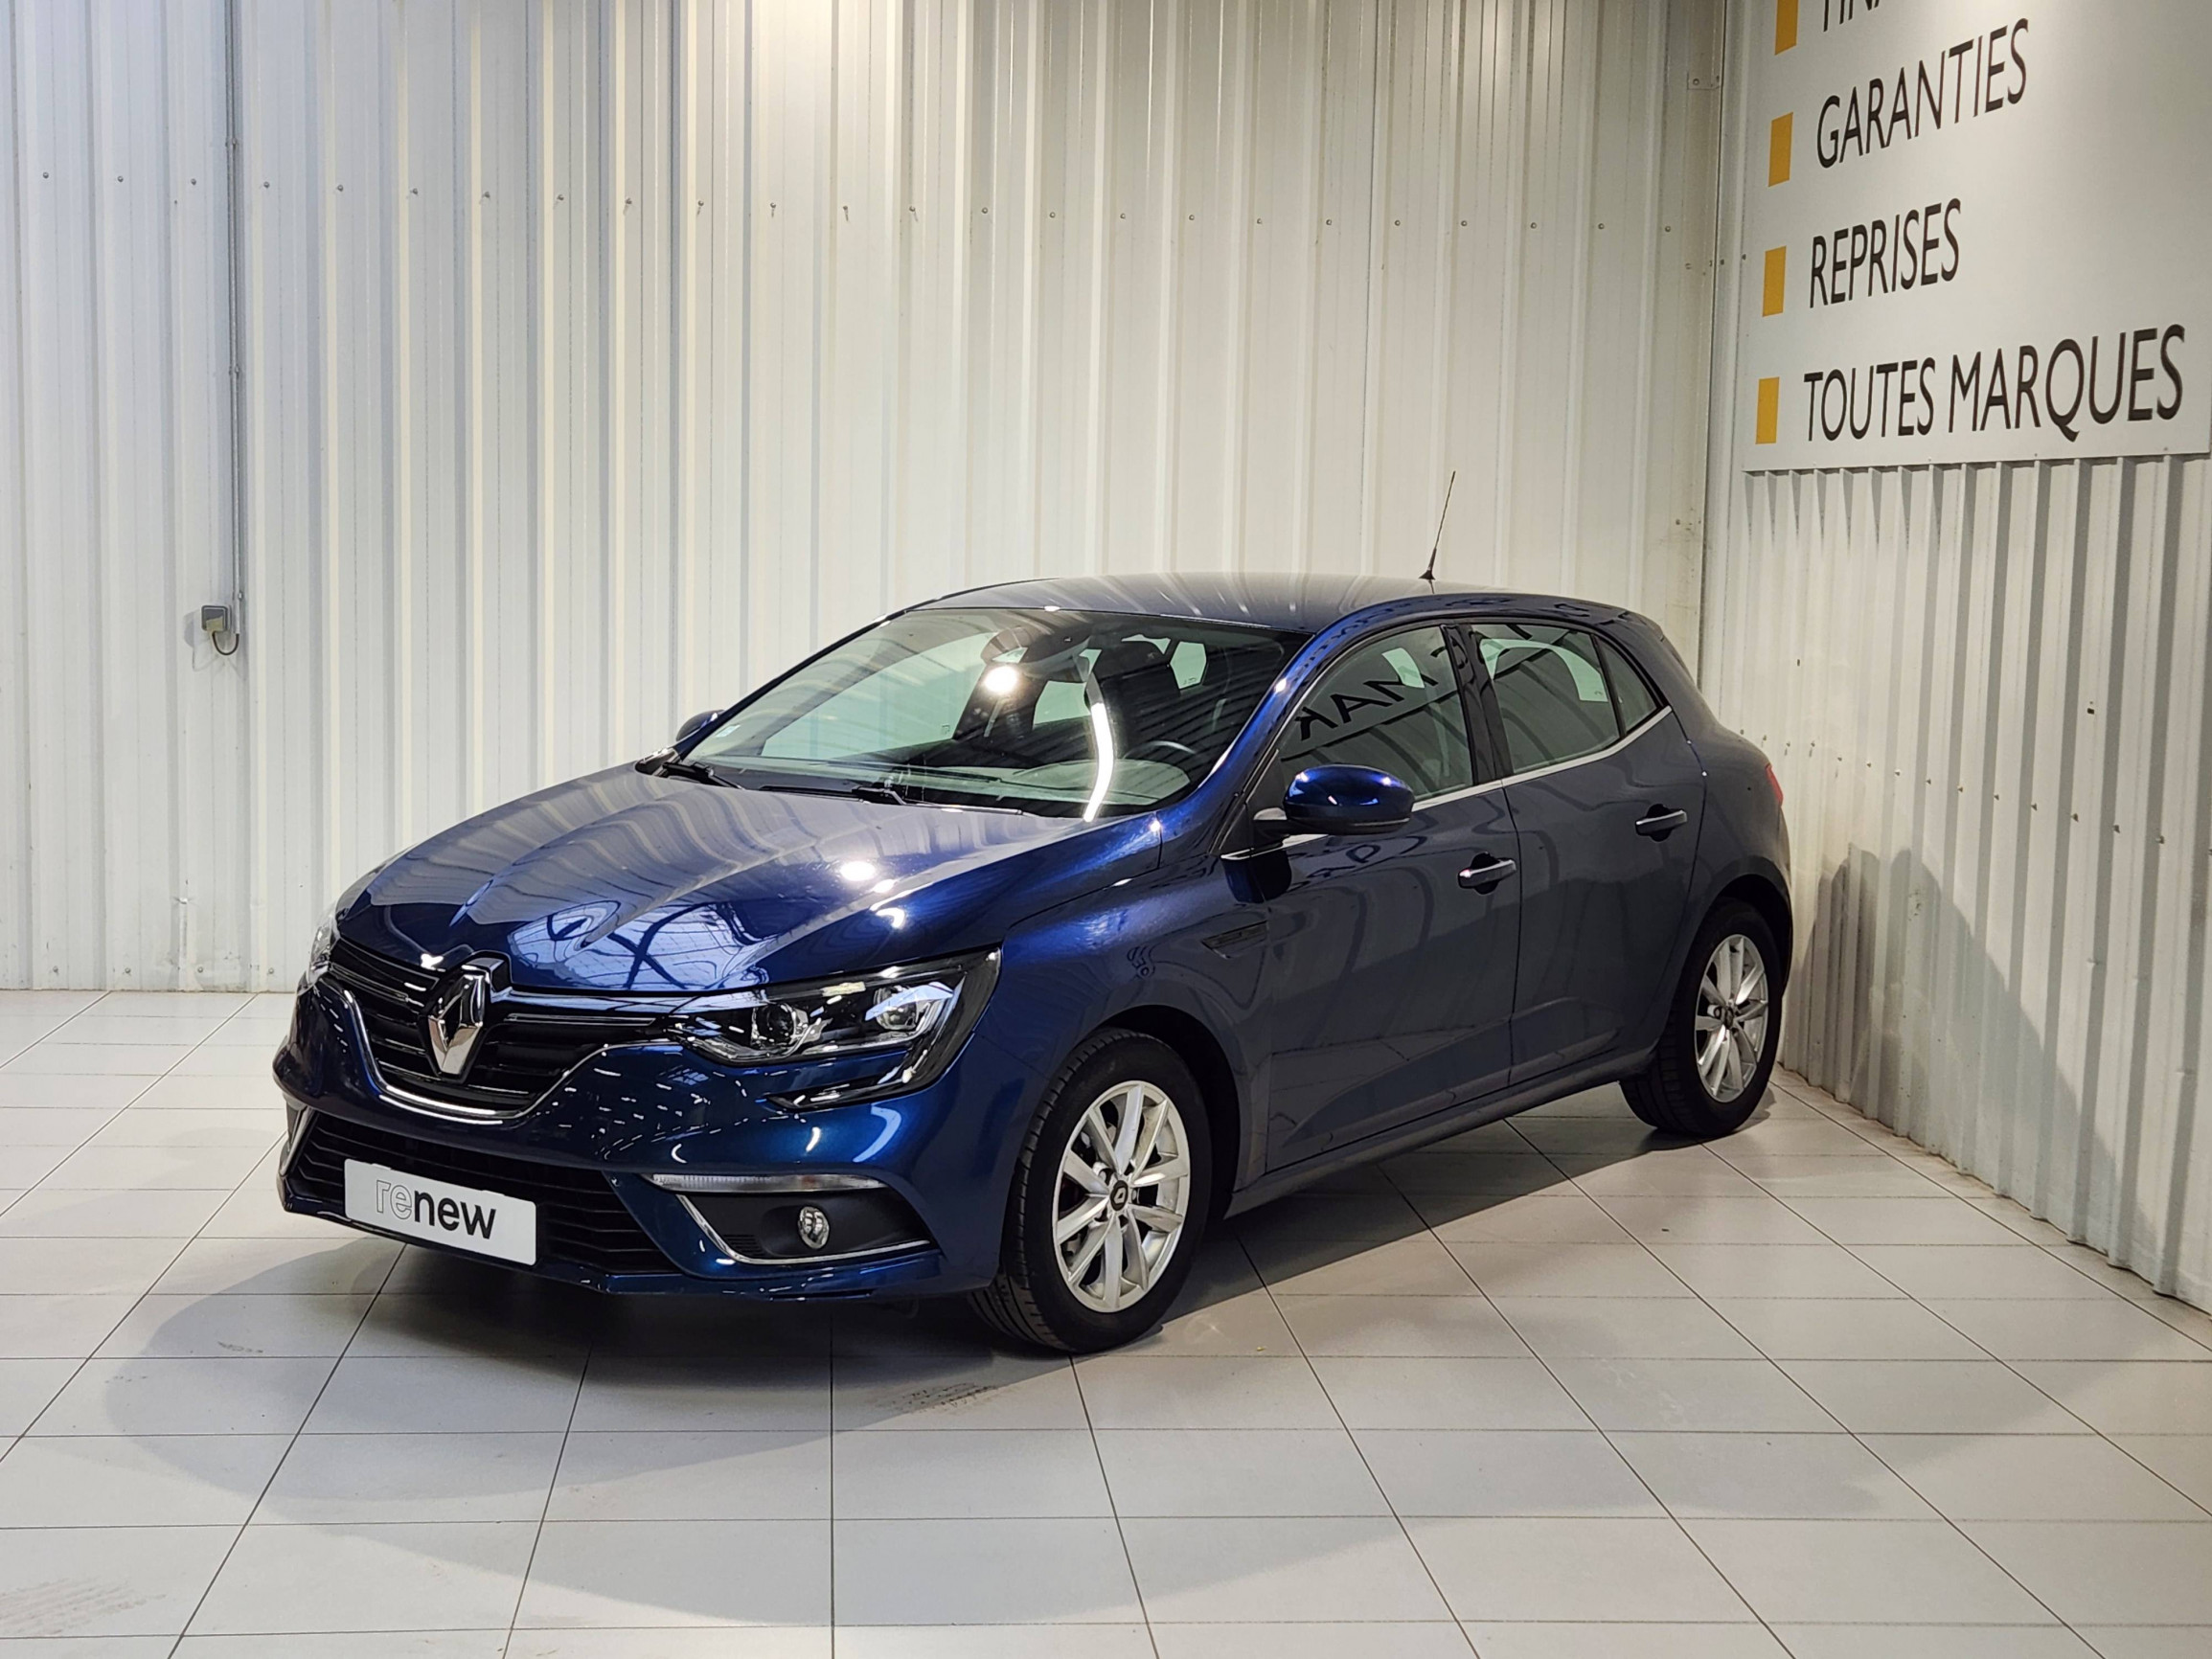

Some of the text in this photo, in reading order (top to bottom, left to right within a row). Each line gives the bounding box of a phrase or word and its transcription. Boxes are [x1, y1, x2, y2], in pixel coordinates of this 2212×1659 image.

[1816, 17, 2029, 169] GARANTIES
[1810, 198, 1961, 308] REPRISES
[1803, 324, 2185, 443] TOUTES MARQUES
[376, 1179, 497, 1239] renew
